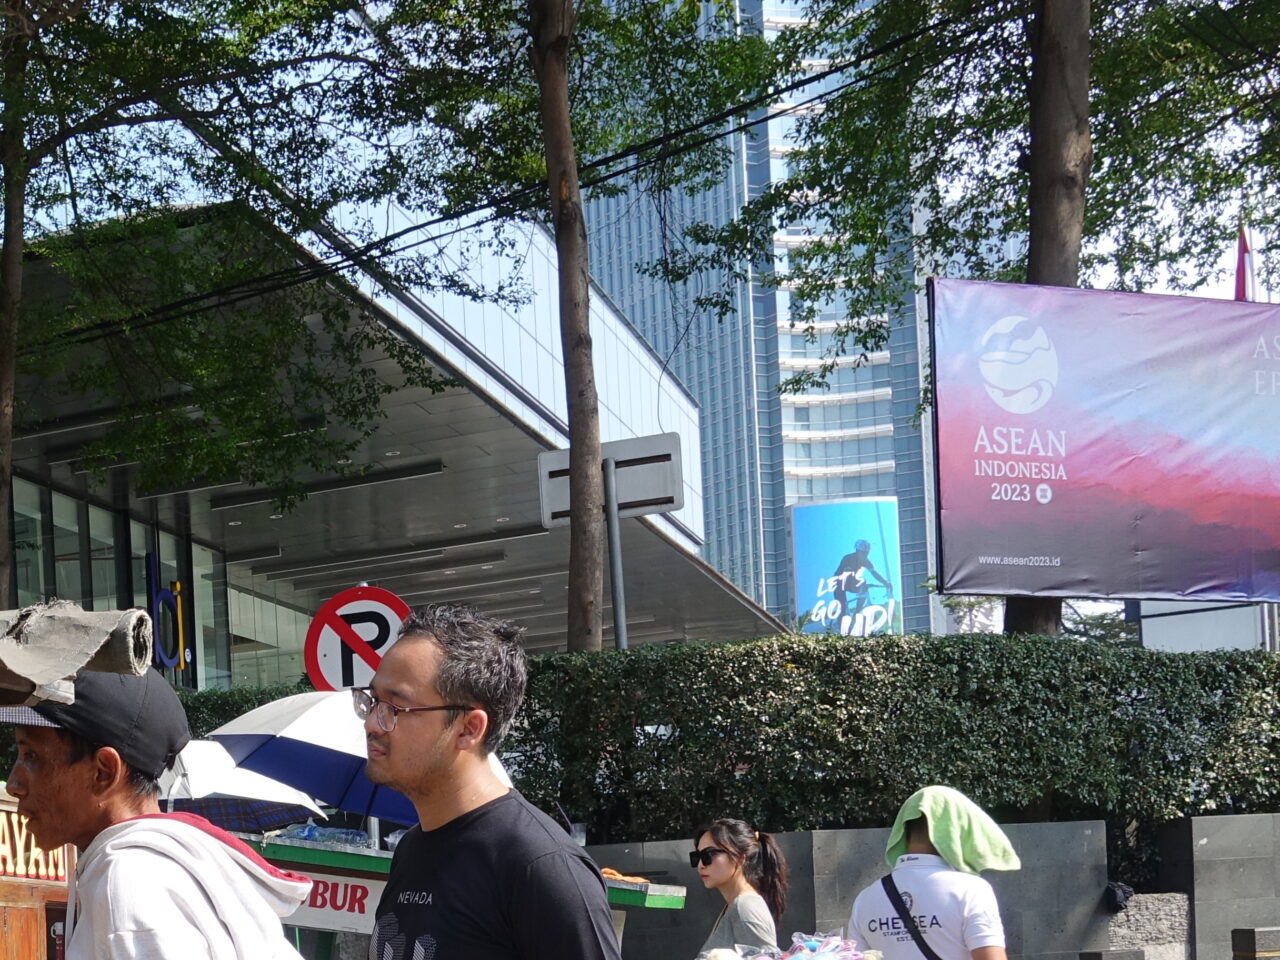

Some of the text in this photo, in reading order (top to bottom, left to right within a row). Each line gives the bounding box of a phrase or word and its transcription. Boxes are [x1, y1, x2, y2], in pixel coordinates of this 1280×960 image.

[973, 425, 1067, 458] ASEAN
[973, 459, 1067, 481] INDONESIA
[991, 482, 1031, 501] 2023
[978, 553, 1061, 568] www.asean2023.id
[816, 566, 866, 597] LET'S
[811, 600, 842, 626] GO
[303, 879, 369, 915] BUR
[397, 891, 433, 905] NEVADA
